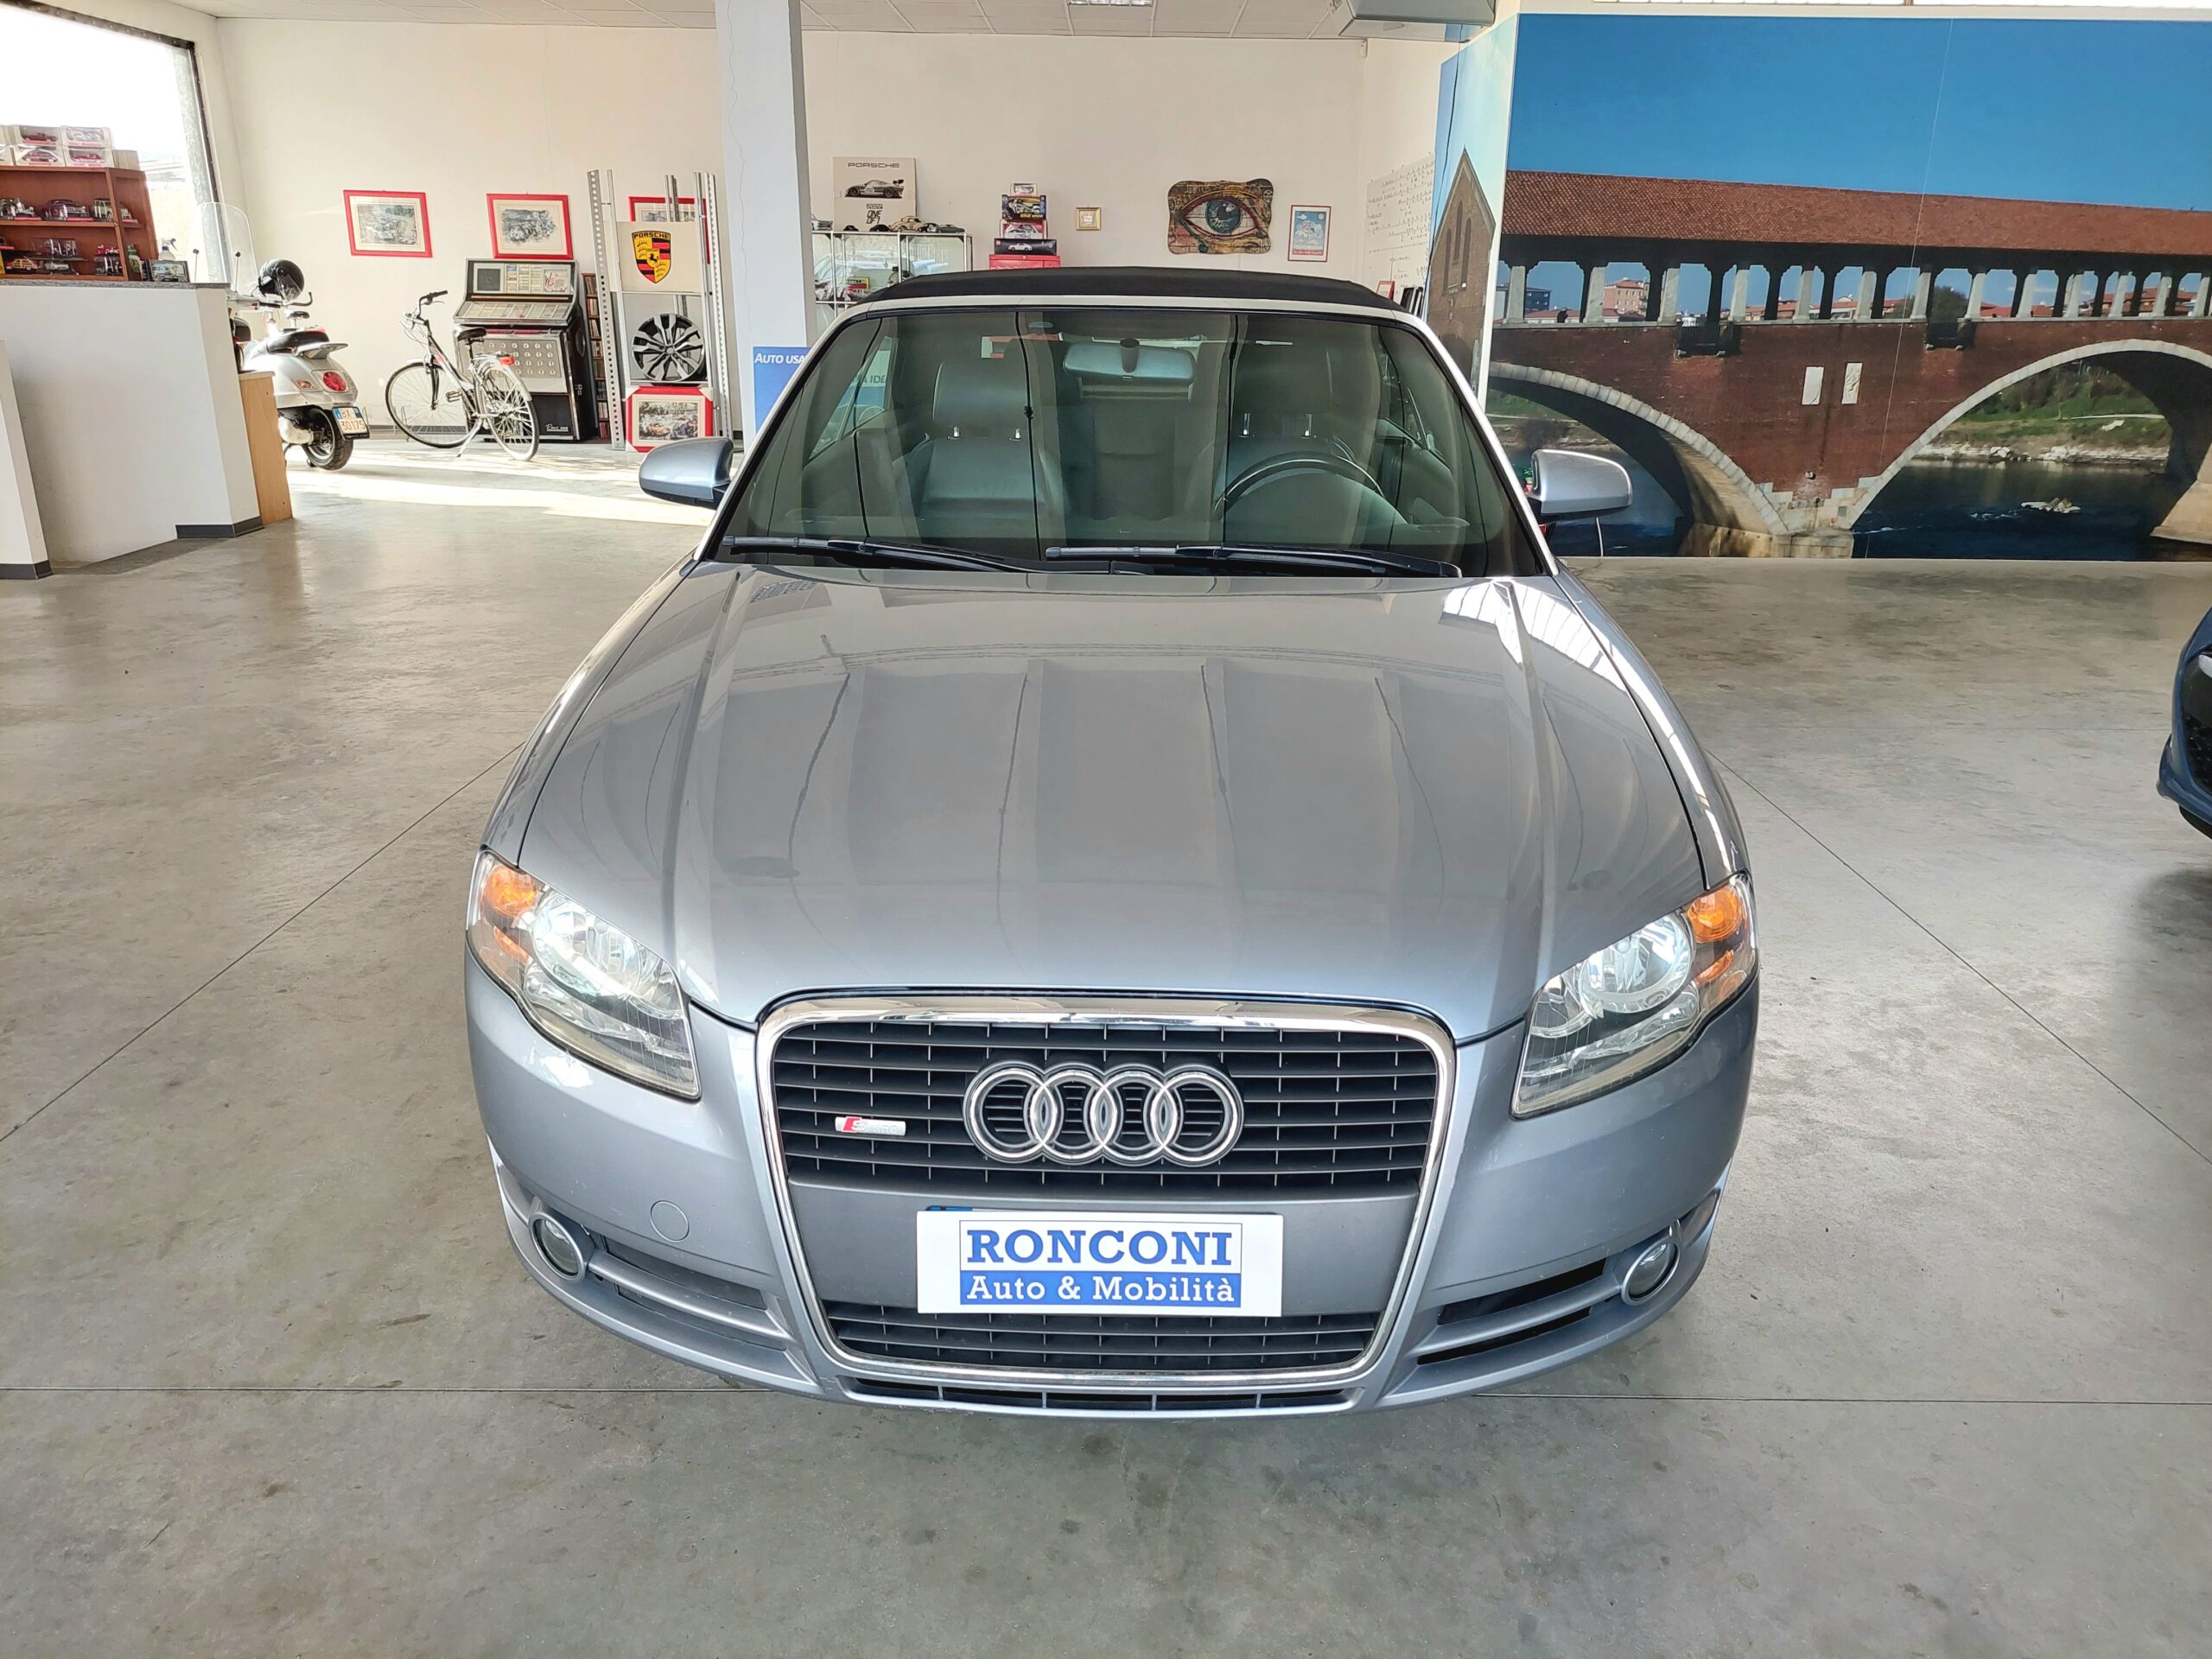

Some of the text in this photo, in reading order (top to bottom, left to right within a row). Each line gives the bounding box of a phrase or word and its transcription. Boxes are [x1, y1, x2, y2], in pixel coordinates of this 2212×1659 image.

[754, 353, 784, 364] AUTO
[340, 421, 365, 430] 30175
[967, 1229, 1232, 1266] RONCONI
[967, 1275, 1235, 1303] Auto & Mobilità
